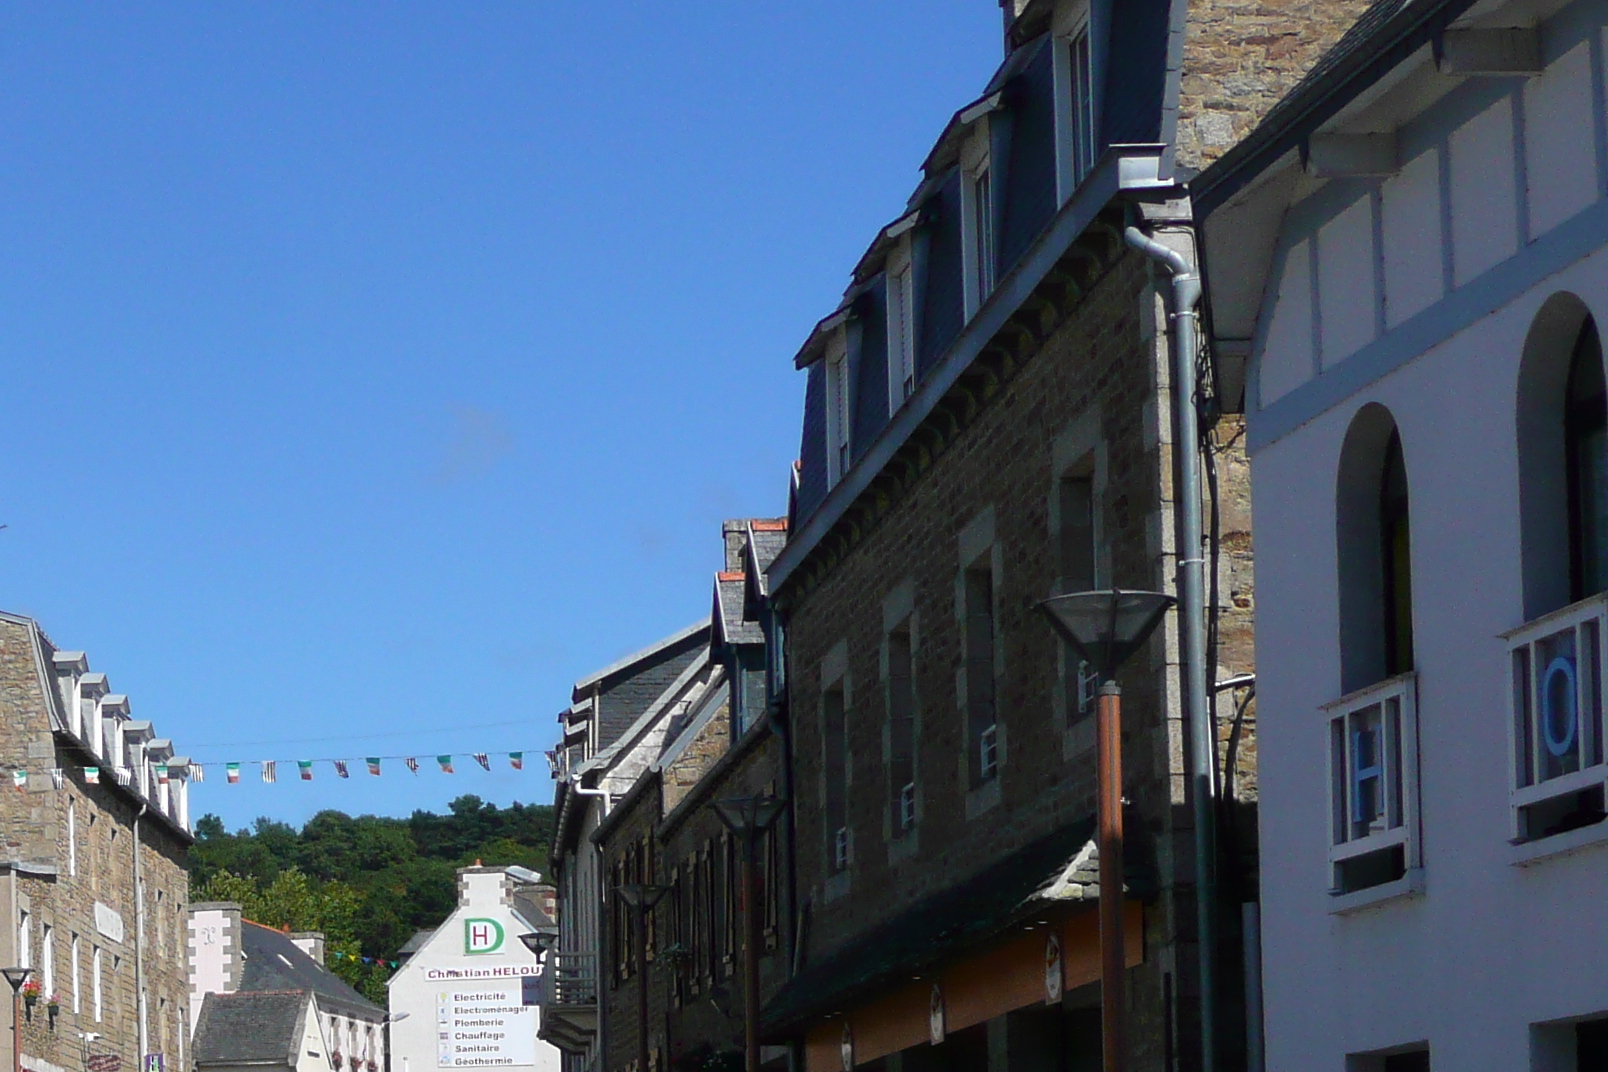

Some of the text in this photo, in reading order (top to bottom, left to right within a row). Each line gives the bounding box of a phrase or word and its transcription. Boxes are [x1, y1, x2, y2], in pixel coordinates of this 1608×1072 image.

[454, 1018, 504, 1027] Plomberie
[454, 1031, 505, 1041] Chauffage
[455, 1044, 500, 1053] Sanitaire
